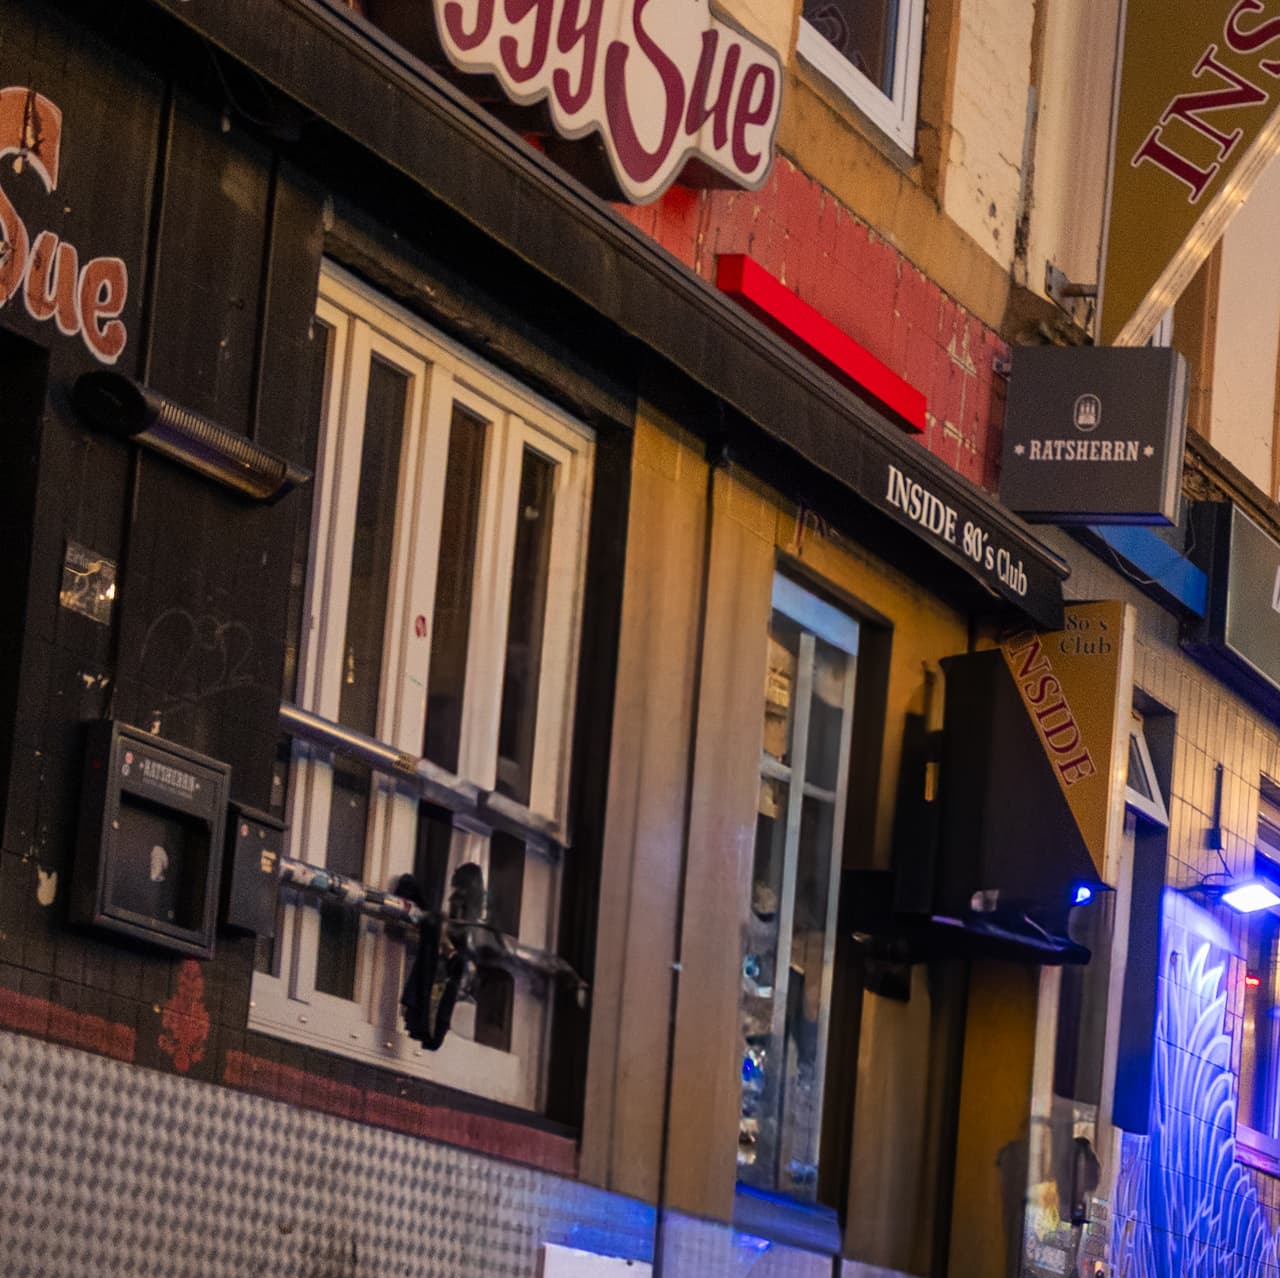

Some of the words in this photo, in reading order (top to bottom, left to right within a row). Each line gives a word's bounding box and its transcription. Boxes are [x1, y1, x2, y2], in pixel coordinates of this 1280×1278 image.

[605, 0, 774, 183] Sue
[1029, 440, 1140, 461] RATSHERRN
[886, 464, 958, 545] INSIDE
[997, 548, 1028, 596] Club
[1009, 634, 1097, 788] NSIDE
[1060, 636, 1112, 655] Club
